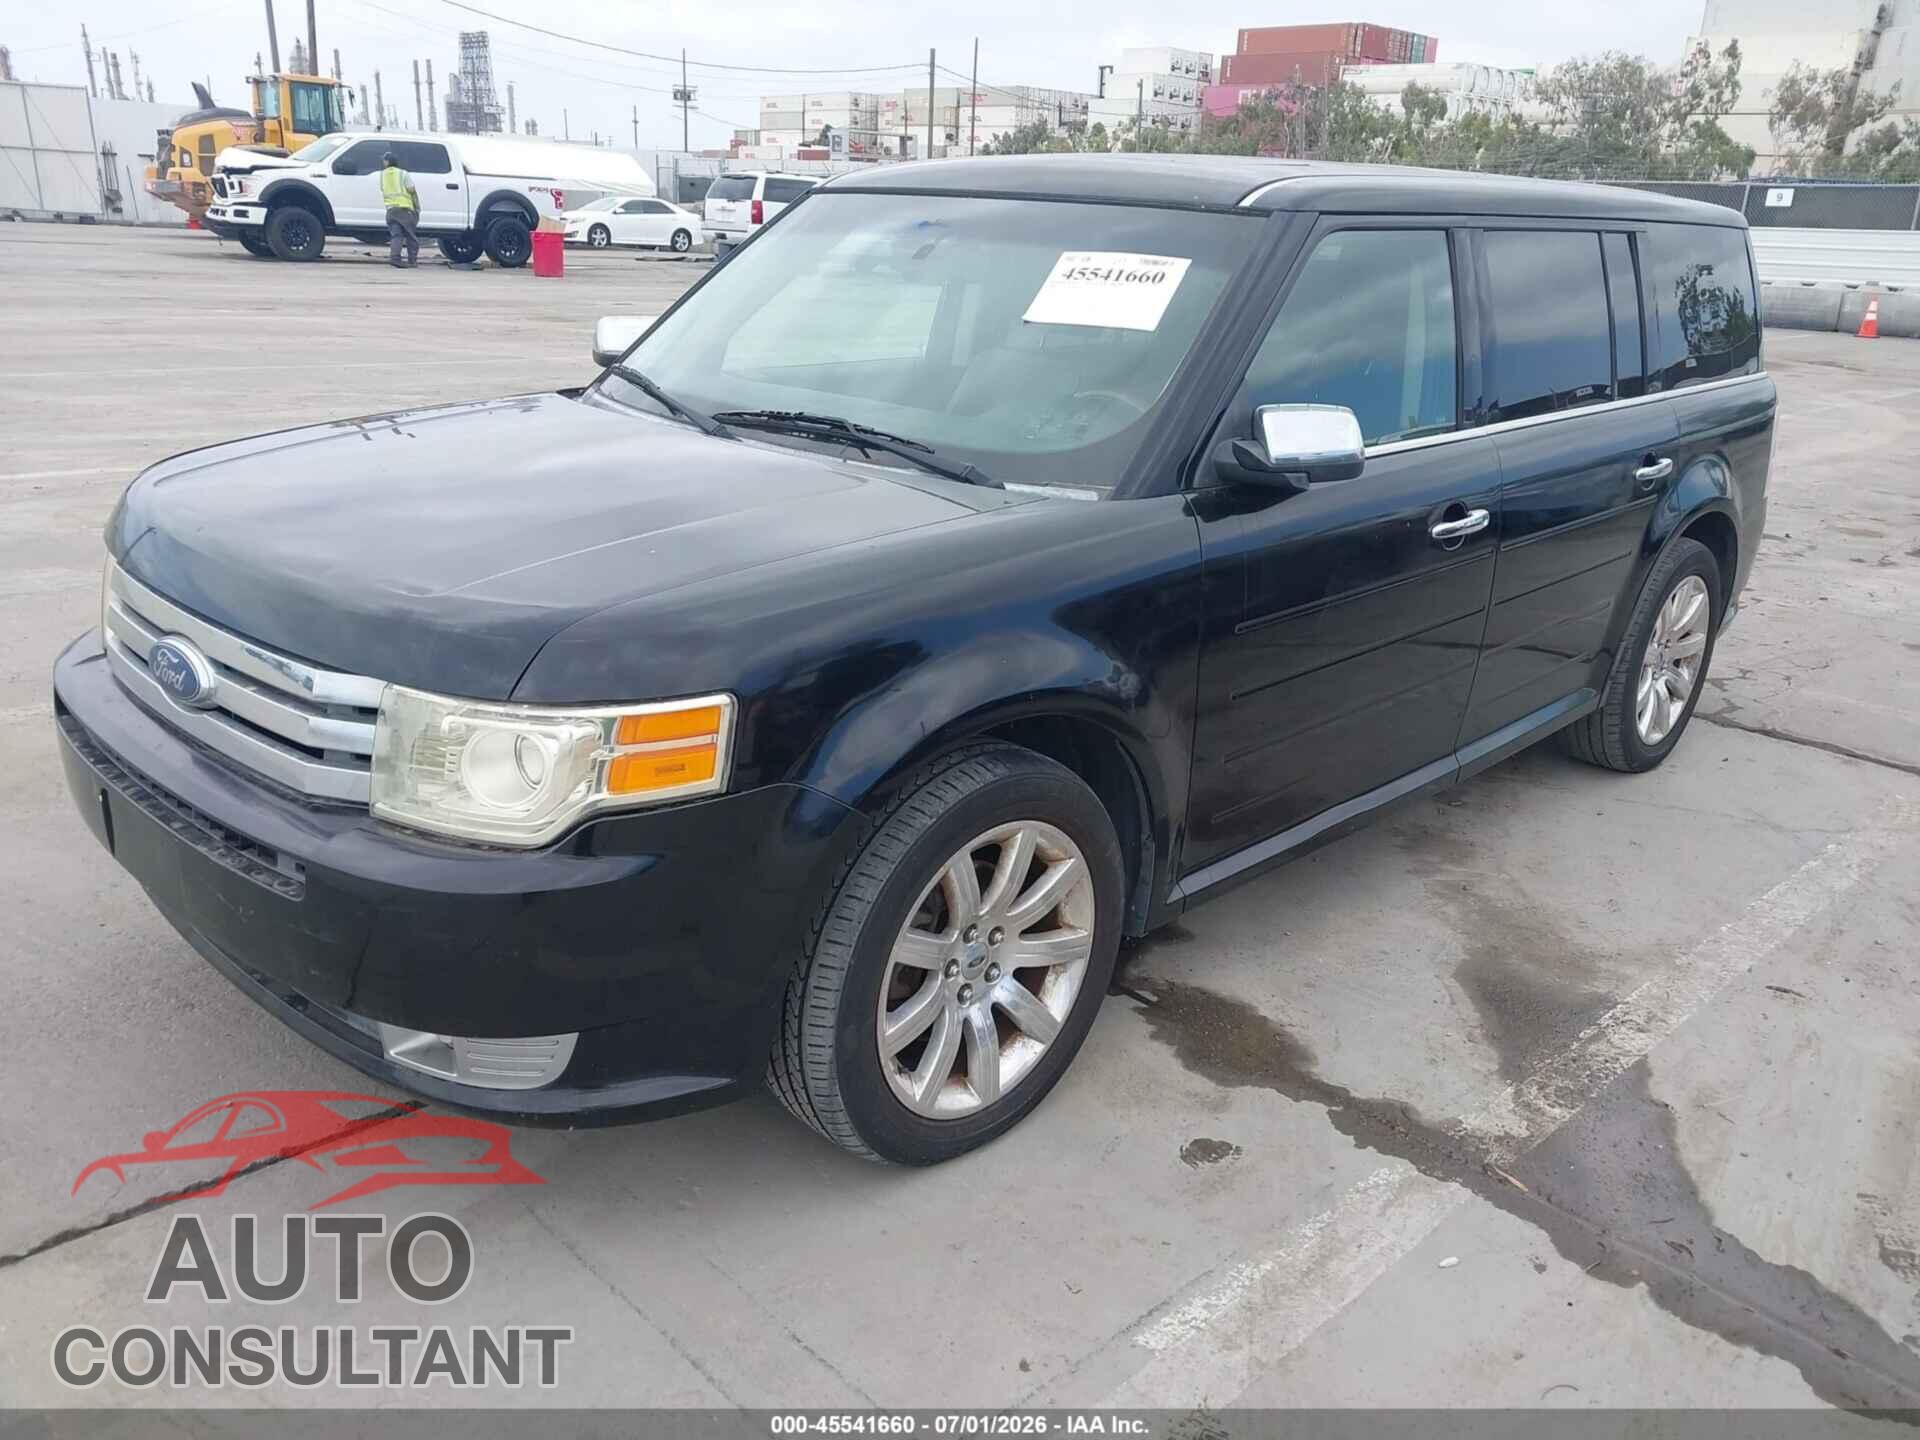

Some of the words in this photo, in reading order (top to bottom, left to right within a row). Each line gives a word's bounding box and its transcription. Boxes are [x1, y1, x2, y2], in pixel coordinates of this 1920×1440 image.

[1776, 192, 1784, 202] 9
[1062, 267, 1166, 285] 45541660
[153, 648, 187, 691] Ford
